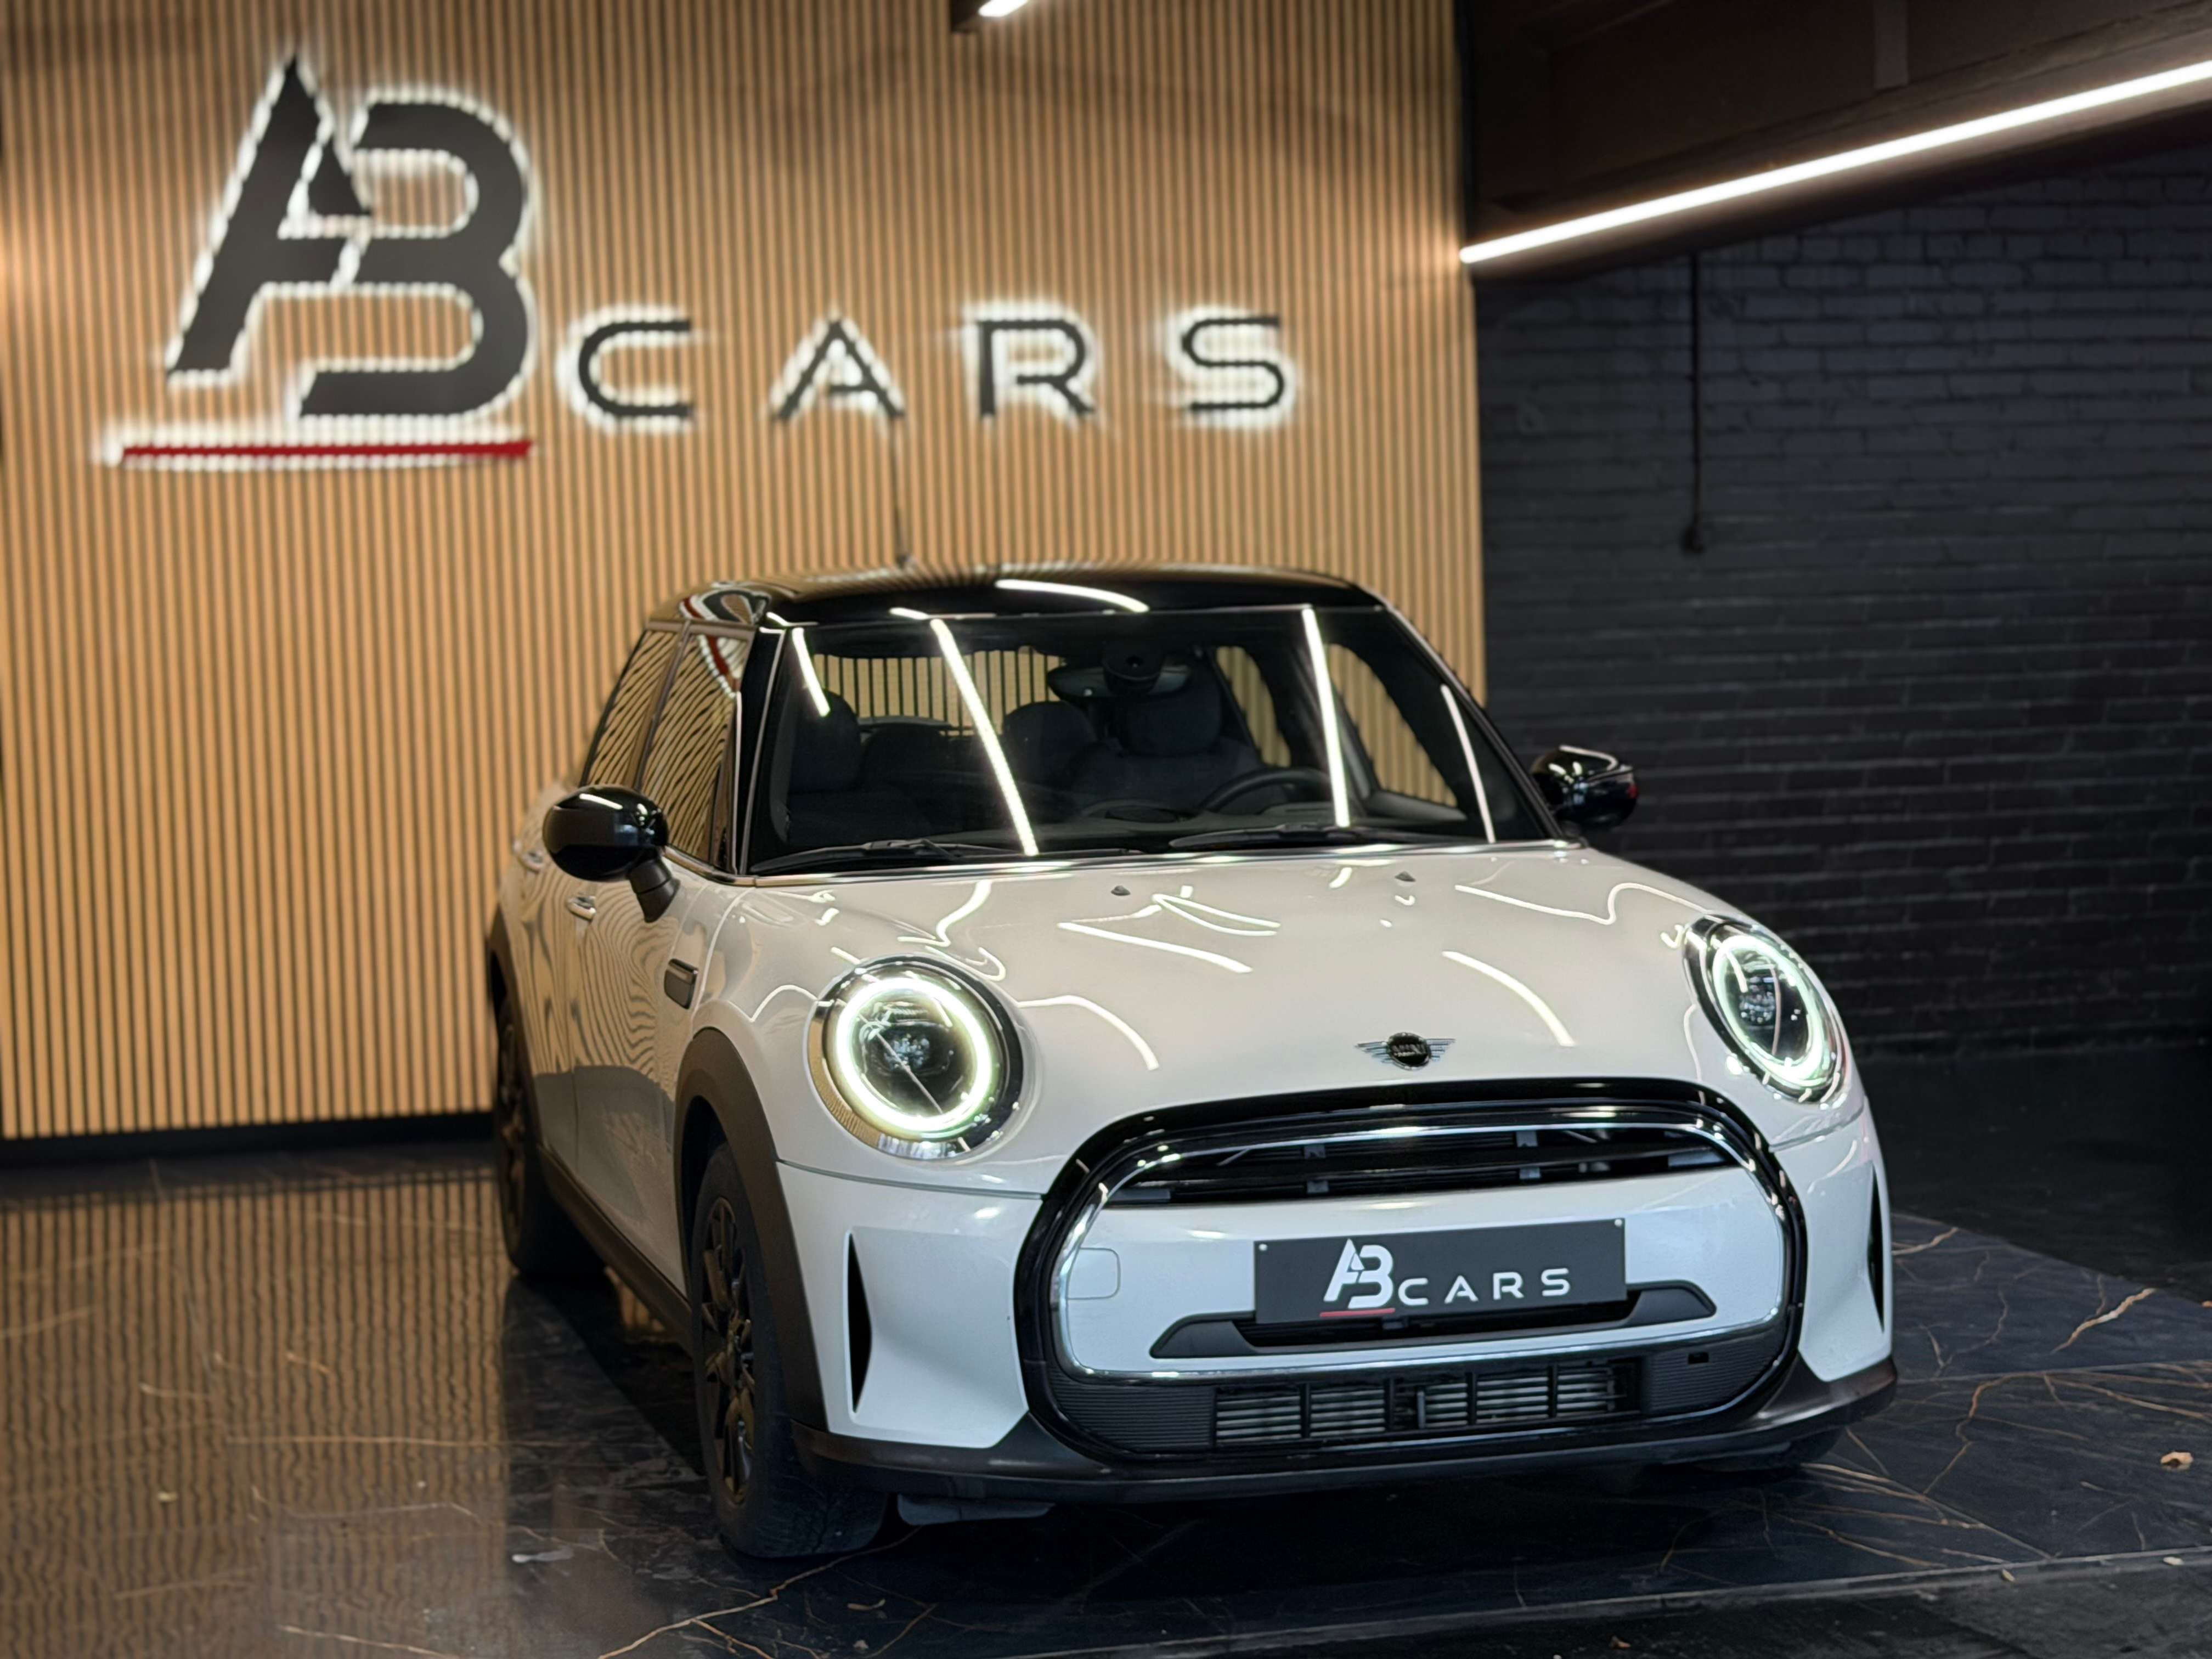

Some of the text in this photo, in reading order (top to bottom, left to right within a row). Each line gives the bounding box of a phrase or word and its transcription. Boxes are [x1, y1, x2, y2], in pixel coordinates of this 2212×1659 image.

[167, 54, 1285, 422] AB CARS
[1323, 1238, 1571, 1310] AB CARS
